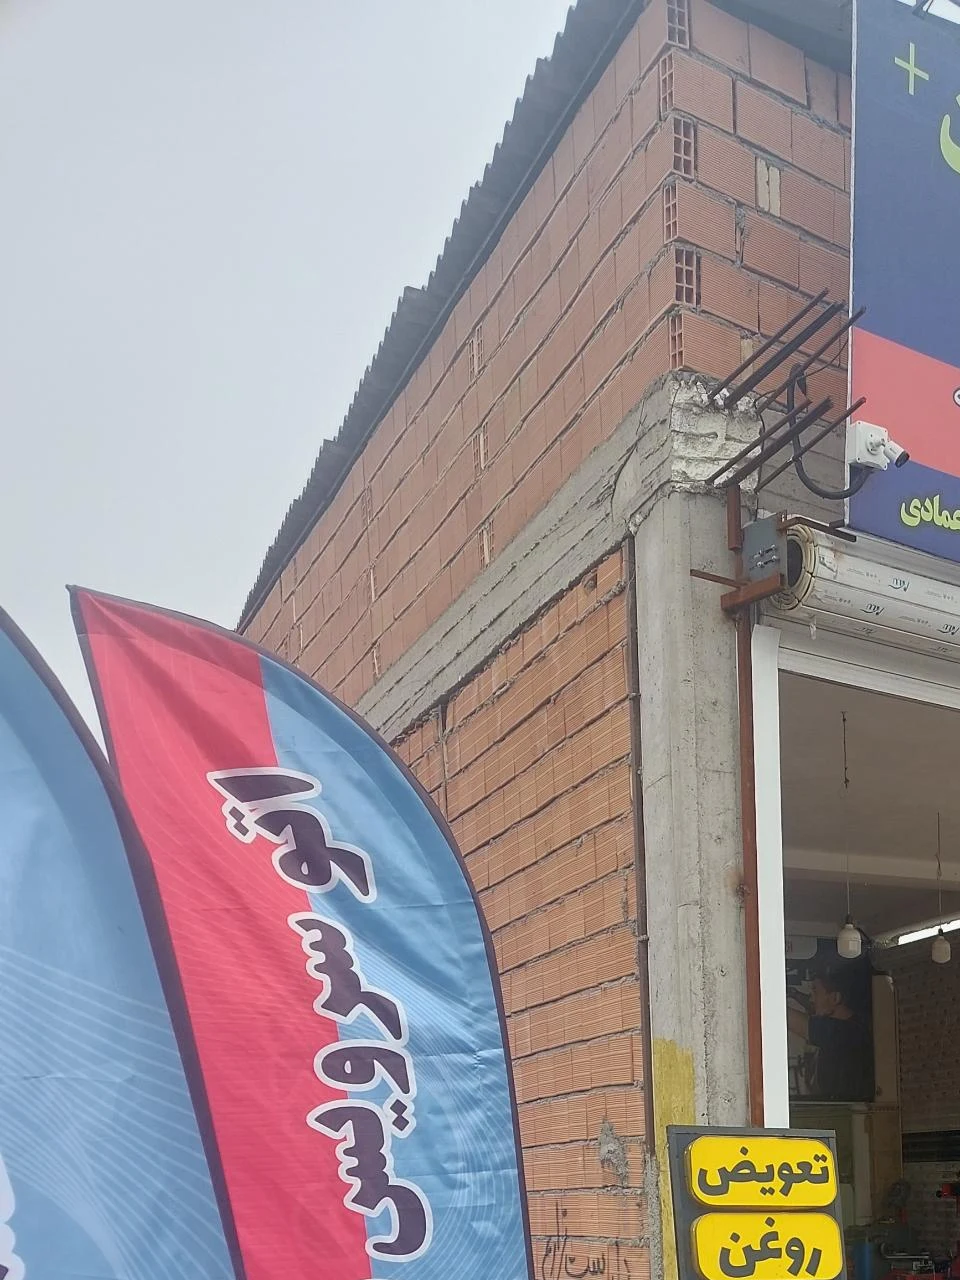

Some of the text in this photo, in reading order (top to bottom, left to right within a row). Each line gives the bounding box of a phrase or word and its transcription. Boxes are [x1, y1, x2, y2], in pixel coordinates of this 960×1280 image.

[206, 767, 377, 903] اتو
[287, 912, 434, 1261] سرویس
[698, 1145, 831, 1197] تعویض
[718, 1216, 822, 1278] روغن
